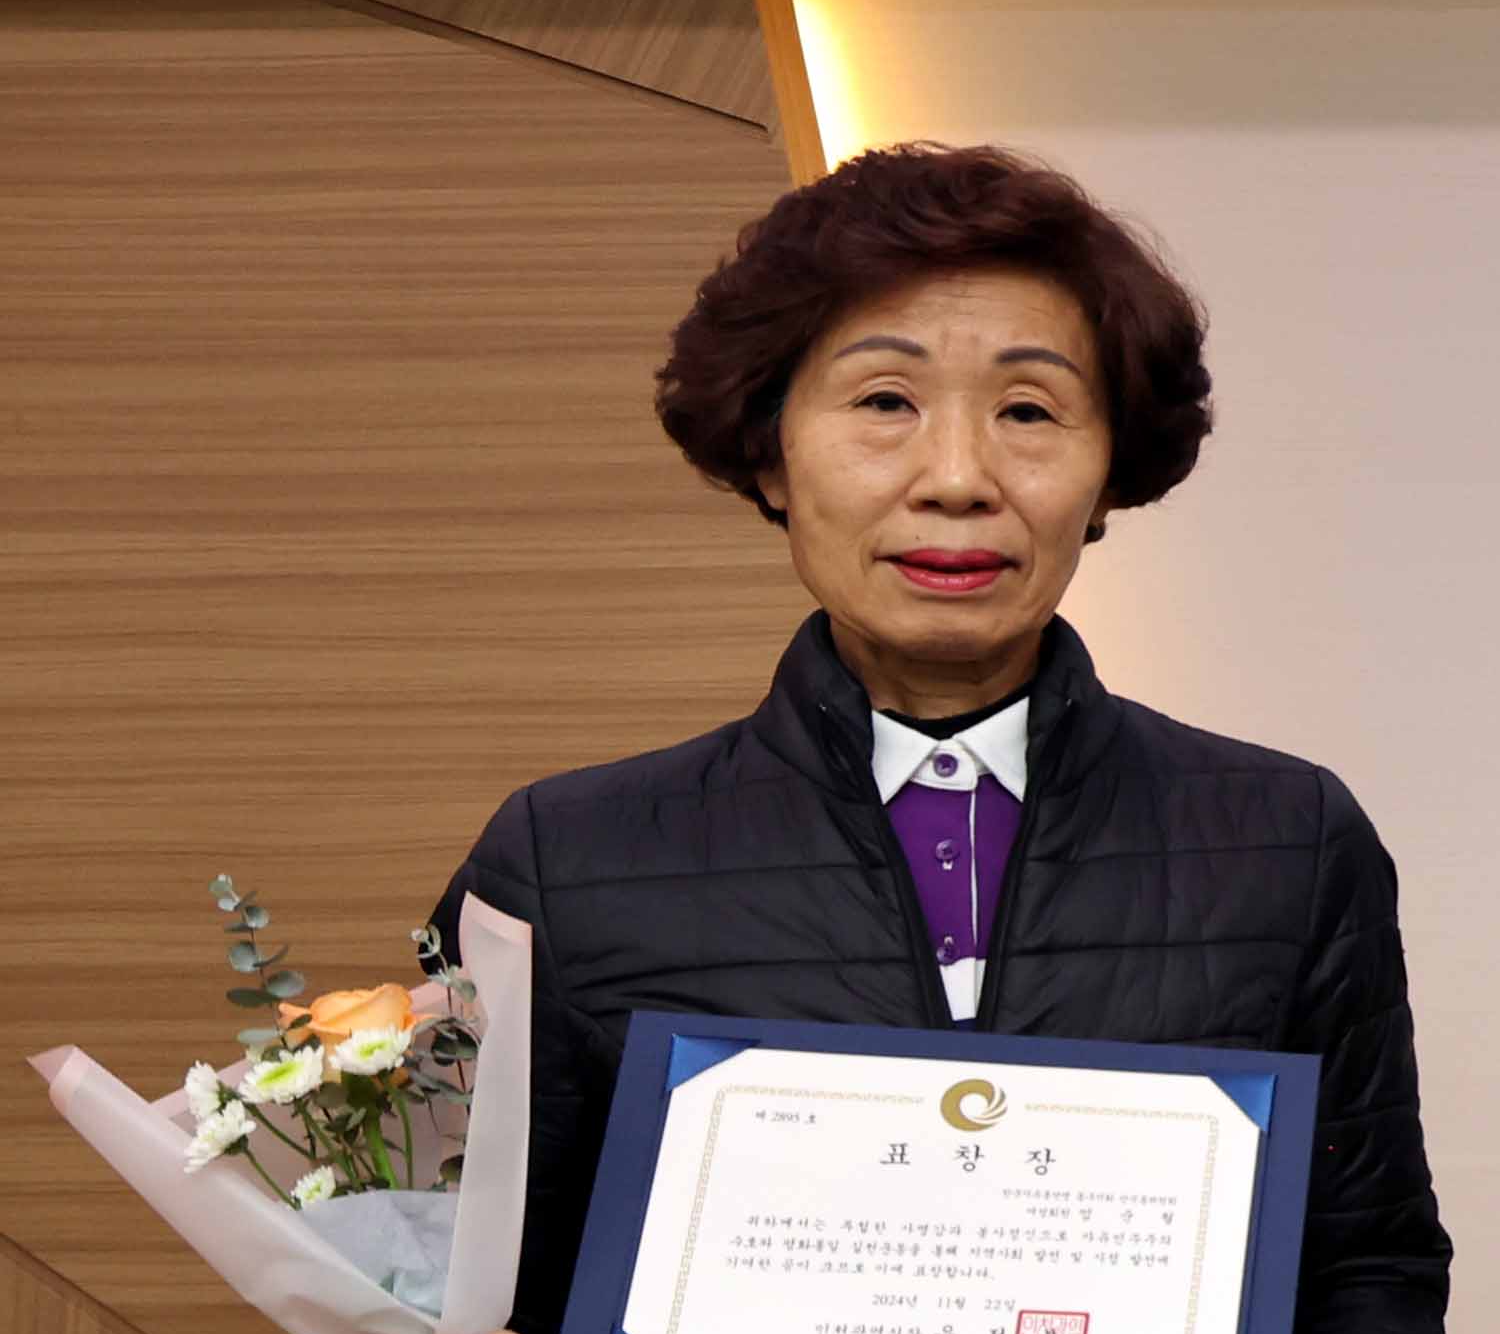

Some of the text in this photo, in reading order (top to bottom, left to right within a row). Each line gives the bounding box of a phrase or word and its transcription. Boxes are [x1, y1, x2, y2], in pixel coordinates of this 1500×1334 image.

[871, 1293, 1016, 1316] 2024년 11월 22일
